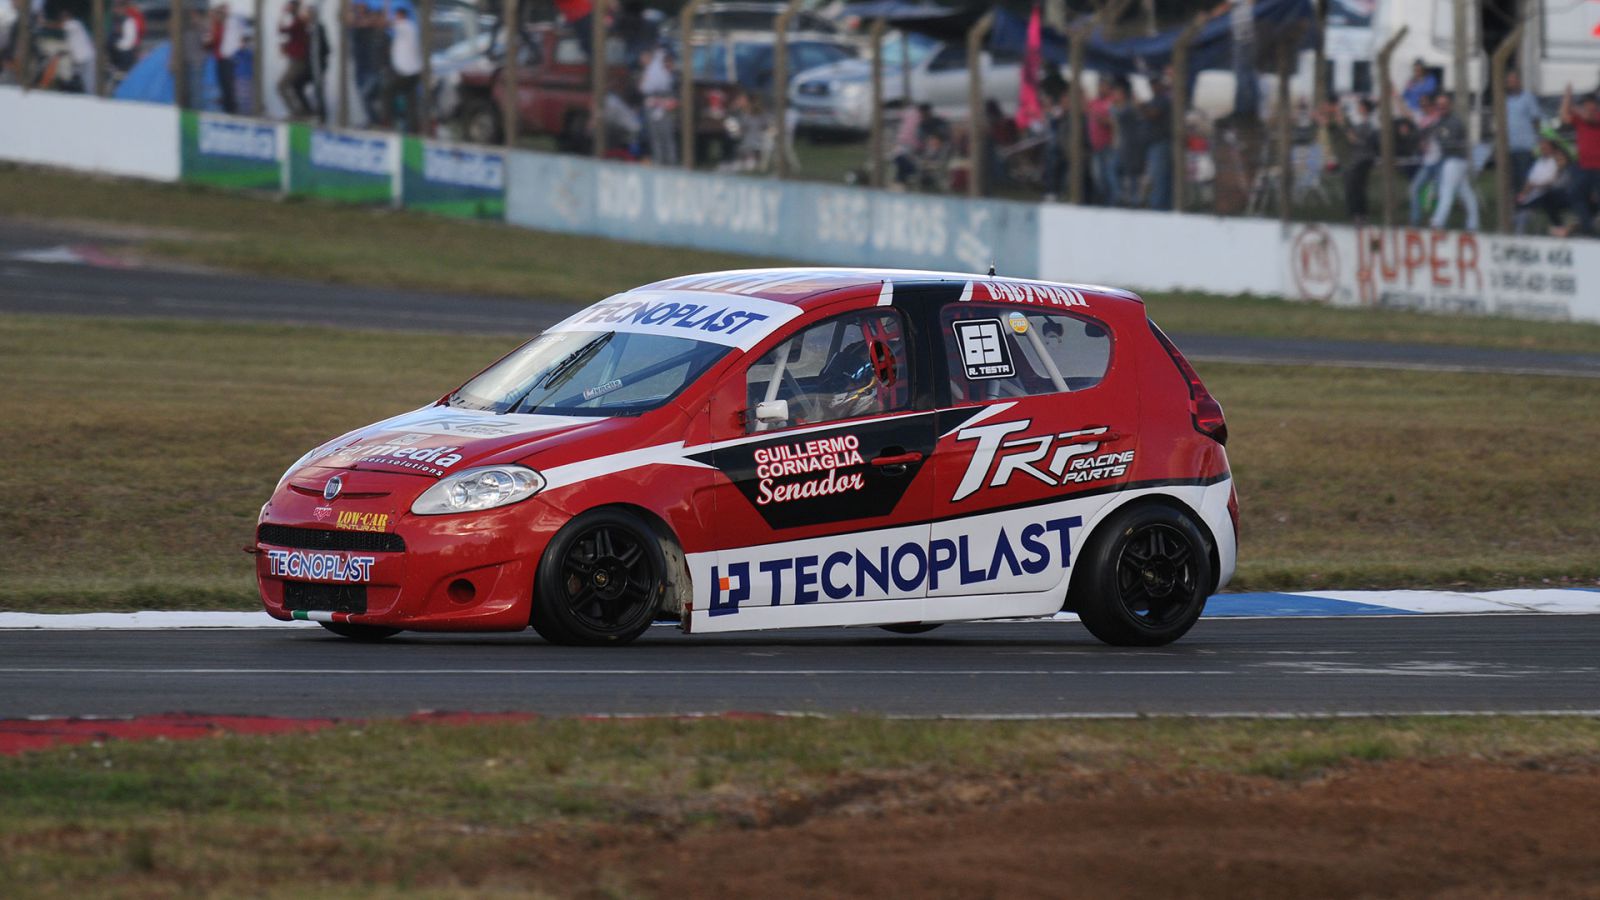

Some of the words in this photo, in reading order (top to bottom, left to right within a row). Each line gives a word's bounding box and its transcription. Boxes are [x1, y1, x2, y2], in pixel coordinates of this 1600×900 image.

[599, 170, 642, 222] RIO
[653, 174, 781, 237] URUGUAY
[573, 300, 770, 335] TECNOPLAST
[960, 323, 1003, 365] 63
[979, 364, 1011, 375] TESTA
[754, 434, 860, 464] GUILLERMO
[756, 449, 865, 479] CORNAGLIA
[1069, 450, 1136, 471] RACING
[387, 458, 446, 477] solutions
[1062, 464, 1127, 485] PARTS
[756, 468, 865, 505] Senador
[337, 510, 389, 527] LOW-CAR
[268, 550, 375, 582] TECNOPLAST
[759, 515, 1083, 607] TECNOPLAST
